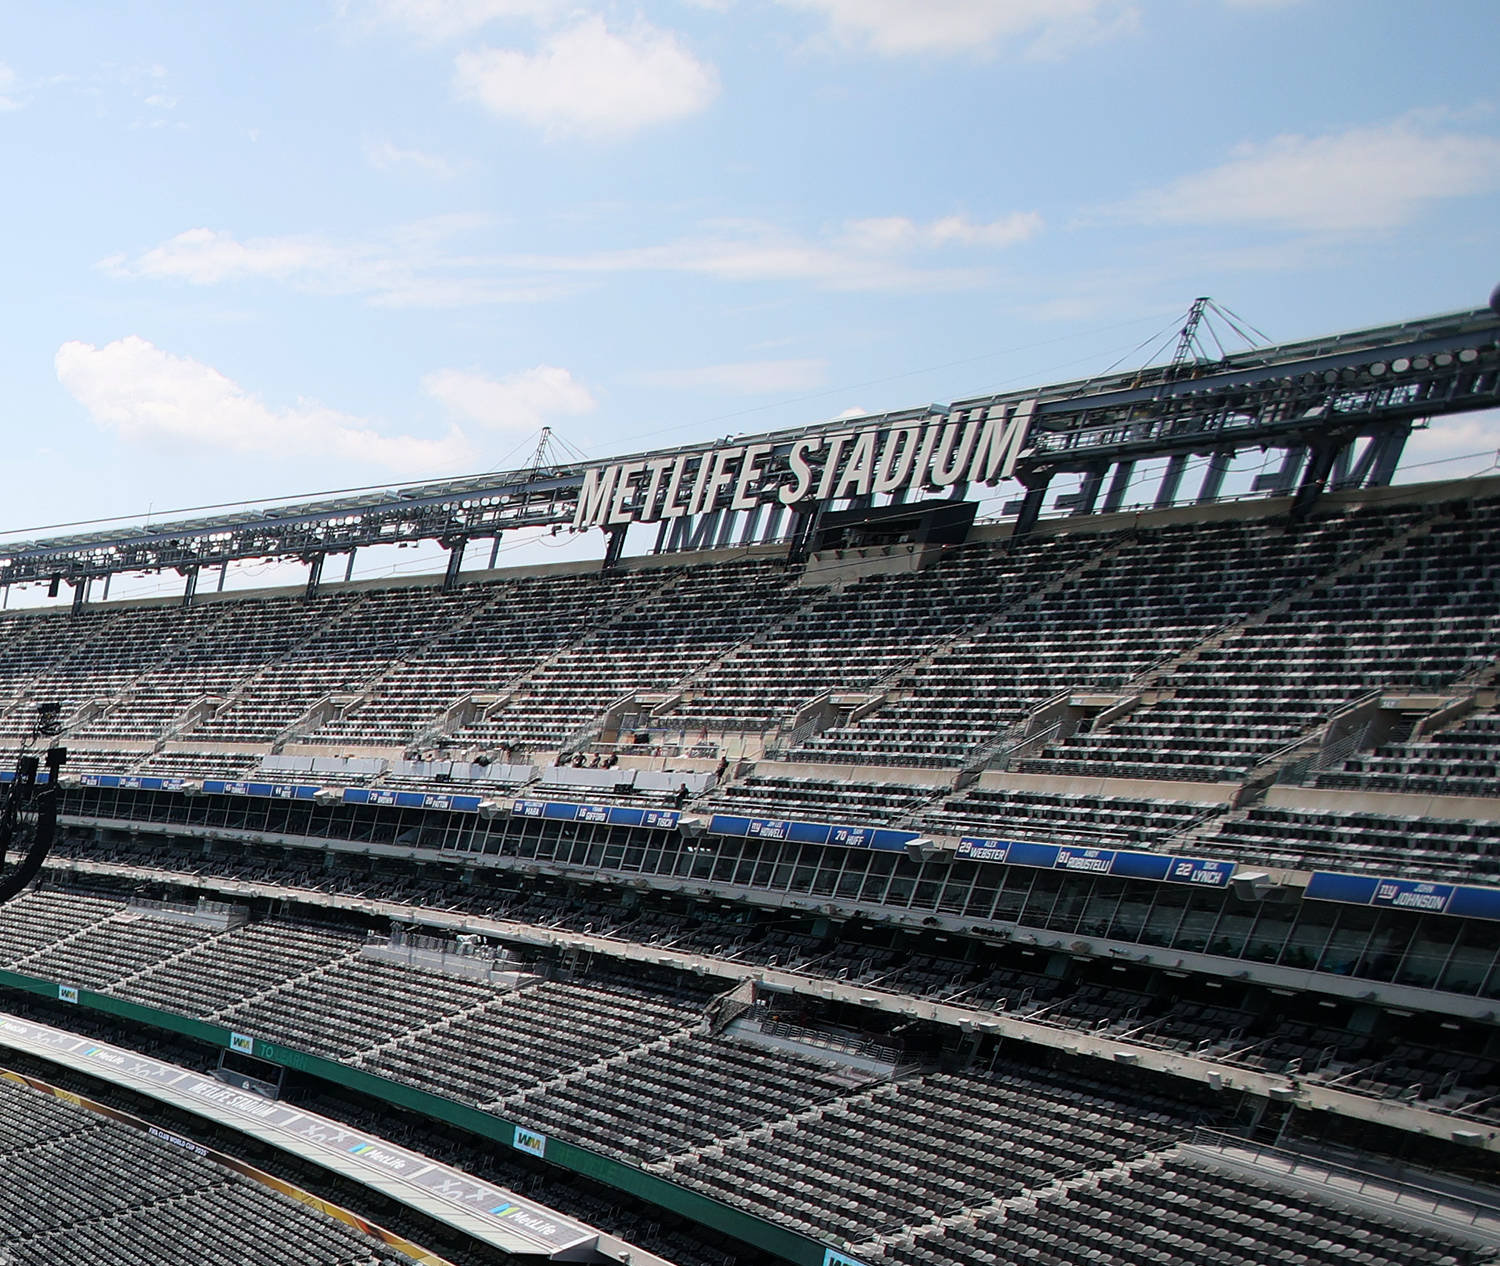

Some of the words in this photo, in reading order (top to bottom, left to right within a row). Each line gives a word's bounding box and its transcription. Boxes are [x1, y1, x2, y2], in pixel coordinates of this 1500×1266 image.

[572, 443, 773, 530] METLIFE
[779, 400, 1037, 505] STADIUM
[834, 829, 848, 841] 70
[845, 835, 865, 846] HUFF
[958, 841, 973, 854] 29
[970, 846, 1006, 861] WEBSTER
[1058, 851, 1071, 864] 81
[1066, 856, 1111, 872] ROBUSTELLI
[1175, 862, 1193, 876] 22
[1190, 869, 1223, 884] LYNCH
[1392, 891, 1446, 910] JOHNSON
[232, 1034, 252, 1050] WM
[517, 1131, 541, 1151] WM
[364, 1149, 406, 1170] MetLife
[508, 1210, 556, 1236] MetLife
